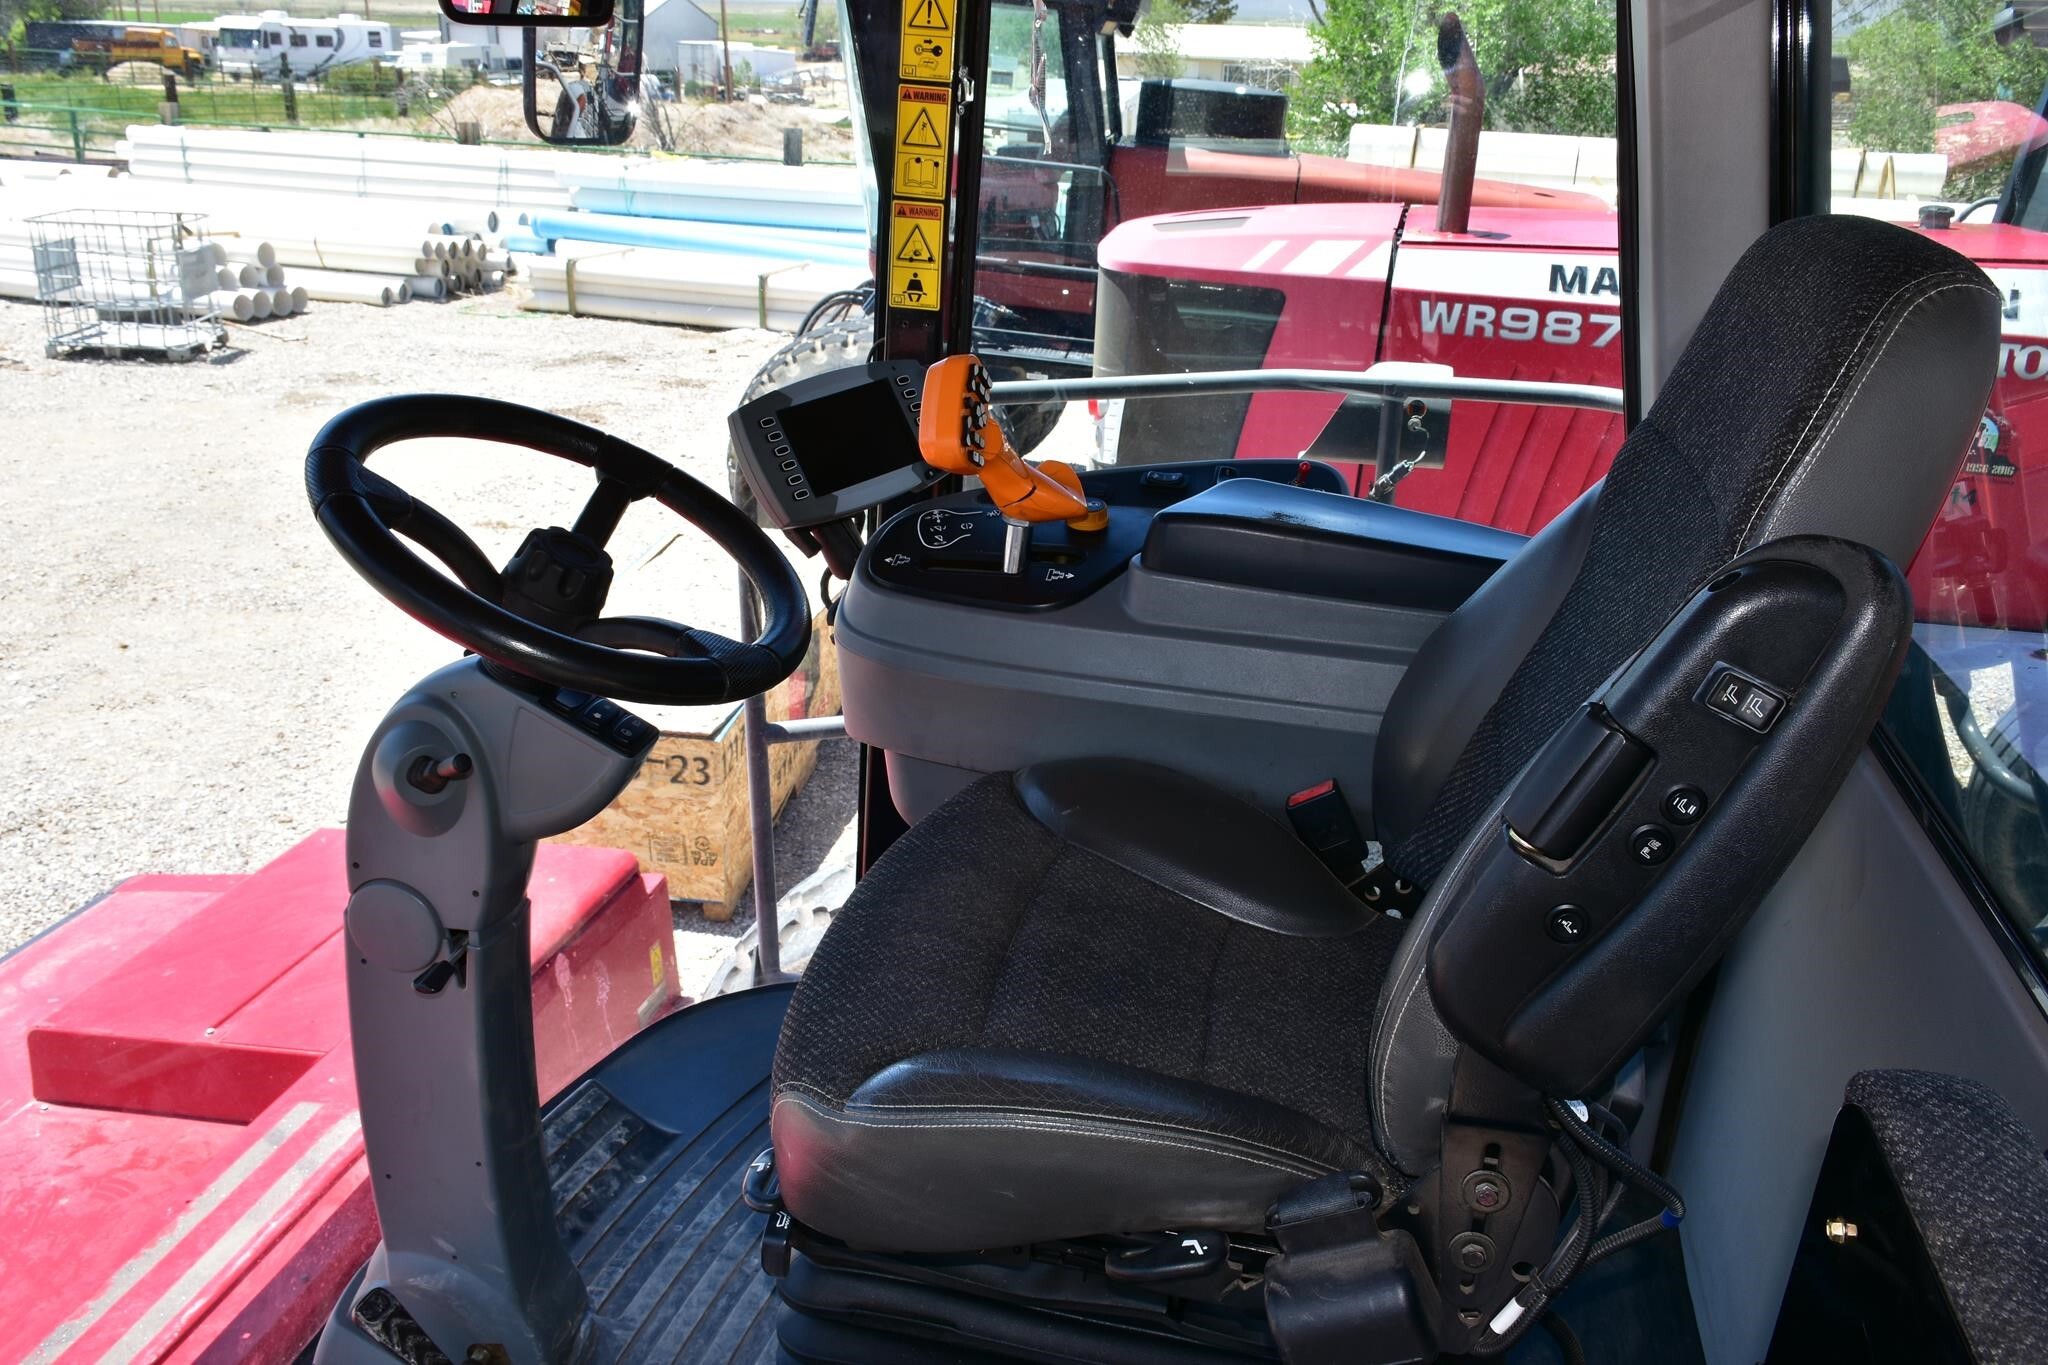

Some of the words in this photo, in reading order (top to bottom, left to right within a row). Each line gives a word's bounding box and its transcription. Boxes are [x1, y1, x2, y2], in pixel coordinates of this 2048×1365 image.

[913, 90, 946, 102] WARNING
[909, 207, 939, 218] WARNING
[1420, 300, 1621, 347] WR987
[1998, 343, 2048, 380] TO
